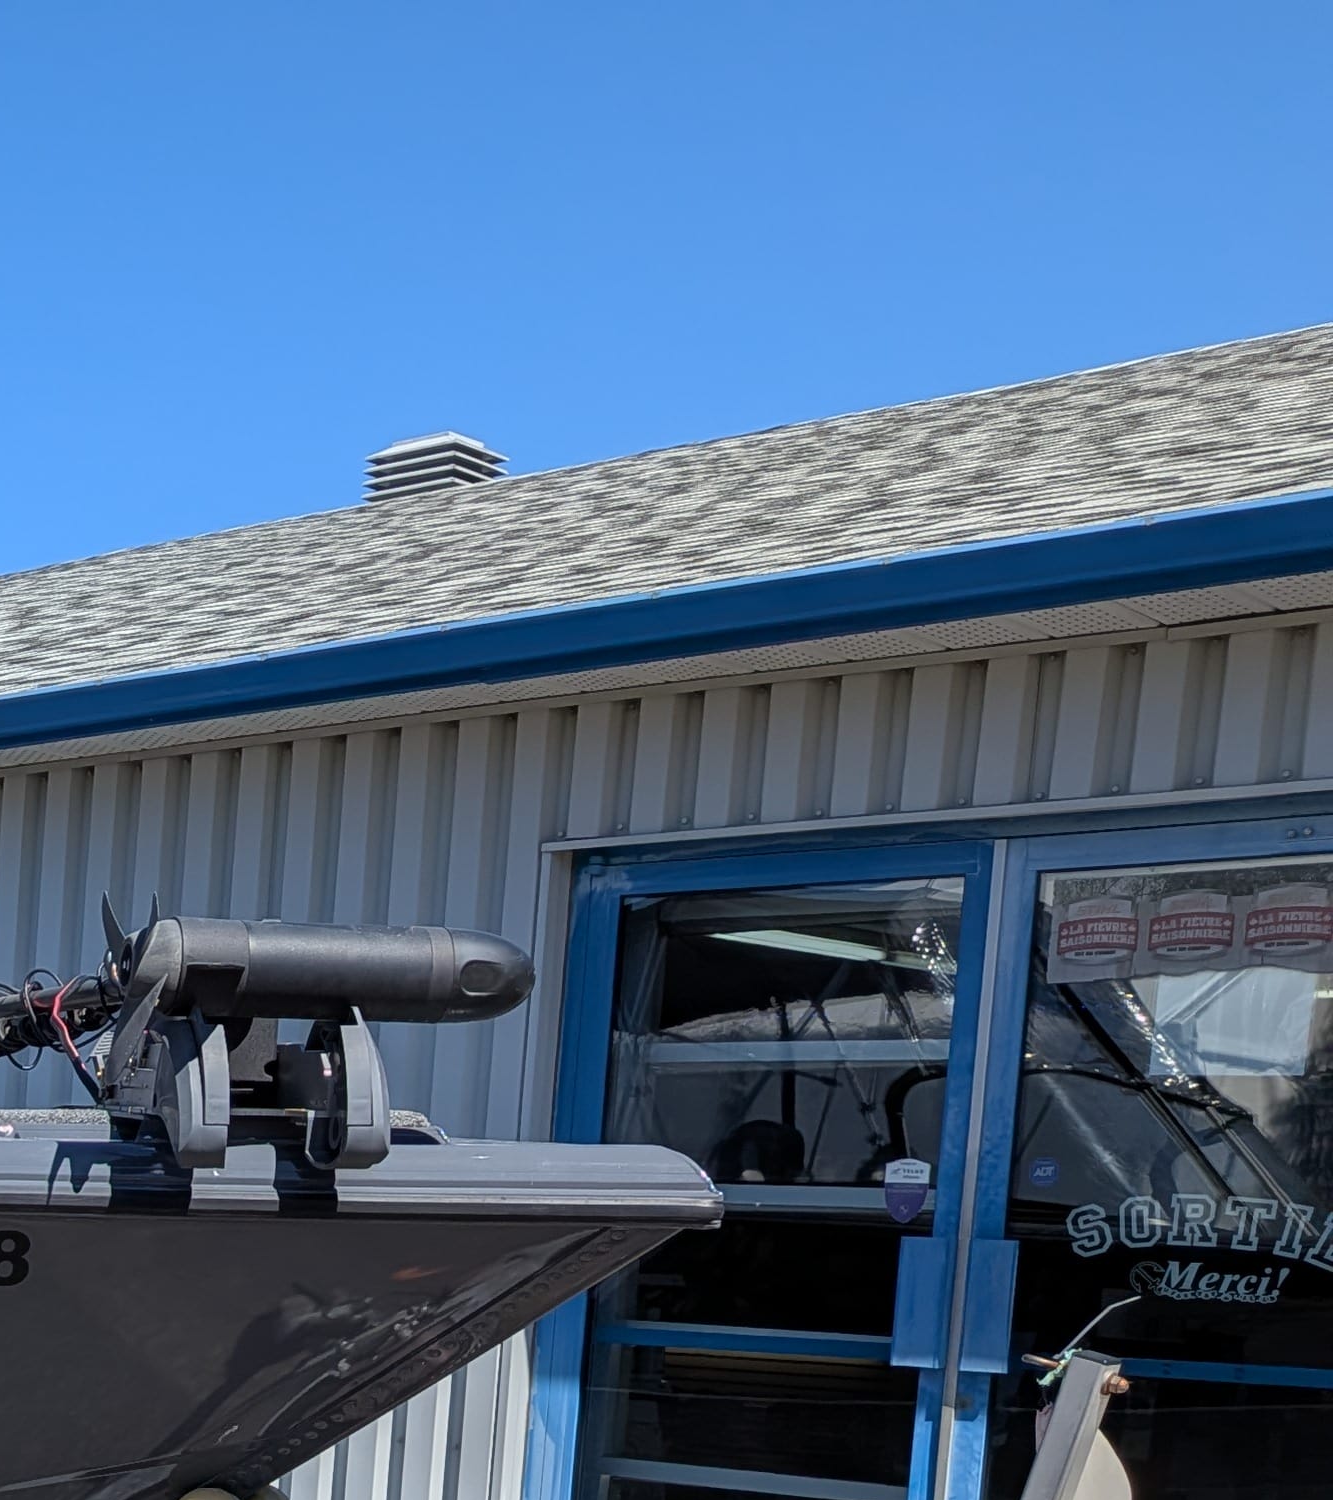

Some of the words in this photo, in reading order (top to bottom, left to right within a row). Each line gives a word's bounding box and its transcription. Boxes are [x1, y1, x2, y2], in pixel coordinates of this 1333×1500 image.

[1162, 920, 1176, 930] LA
[1259, 914, 1273, 925] LA
[1069, 925, 1084, 935] LA
[1033, 1166, 1055, 1177] ADT
[1159, 1260, 1290, 1297] Merci!
